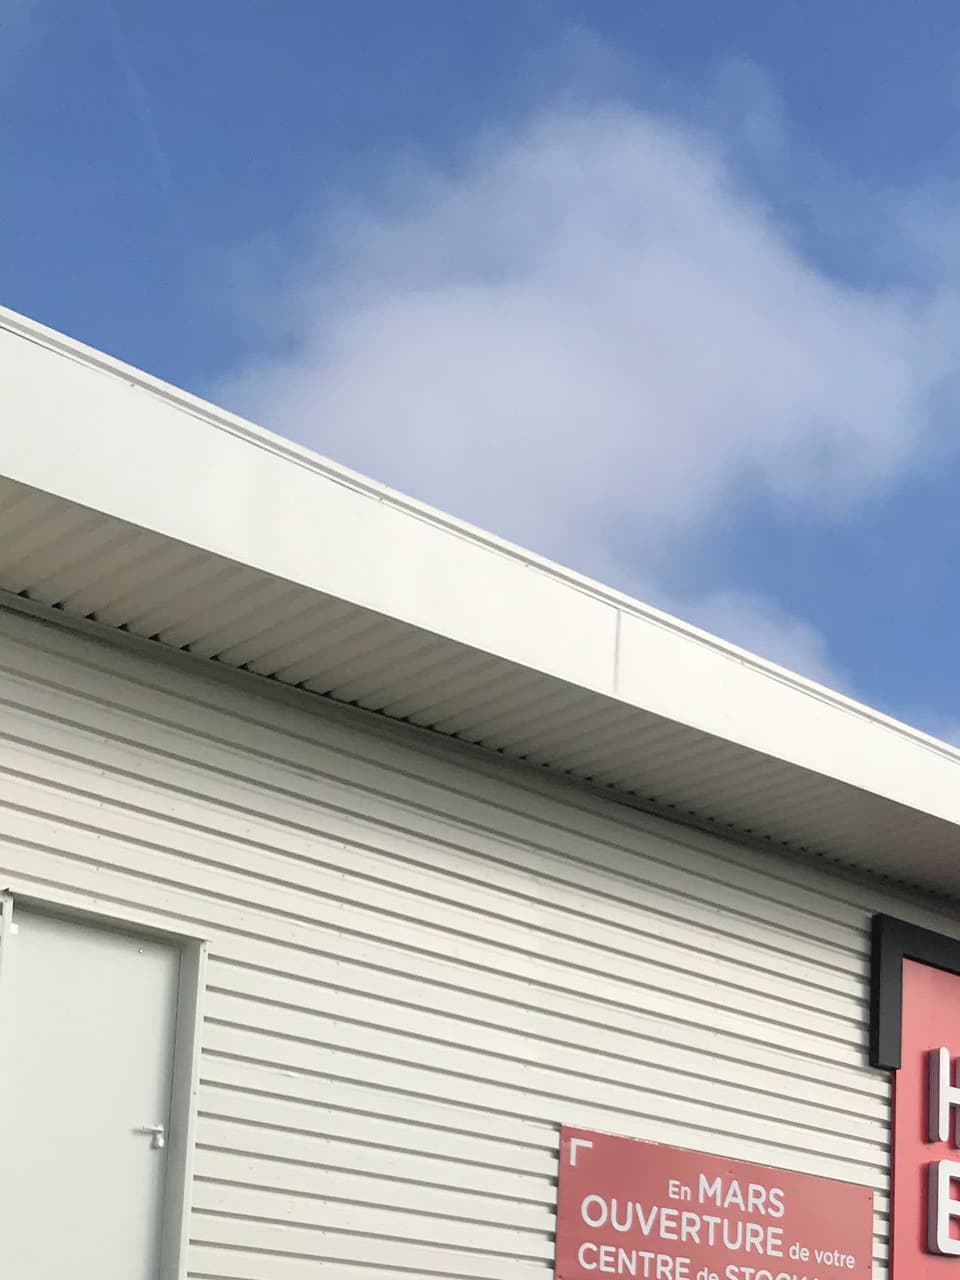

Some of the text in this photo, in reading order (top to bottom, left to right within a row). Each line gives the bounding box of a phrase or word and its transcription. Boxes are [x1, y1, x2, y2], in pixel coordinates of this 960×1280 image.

[668, 1174, 785, 1218] En MARS
[581, 1195, 855, 1269] OUVERTURE de votre
